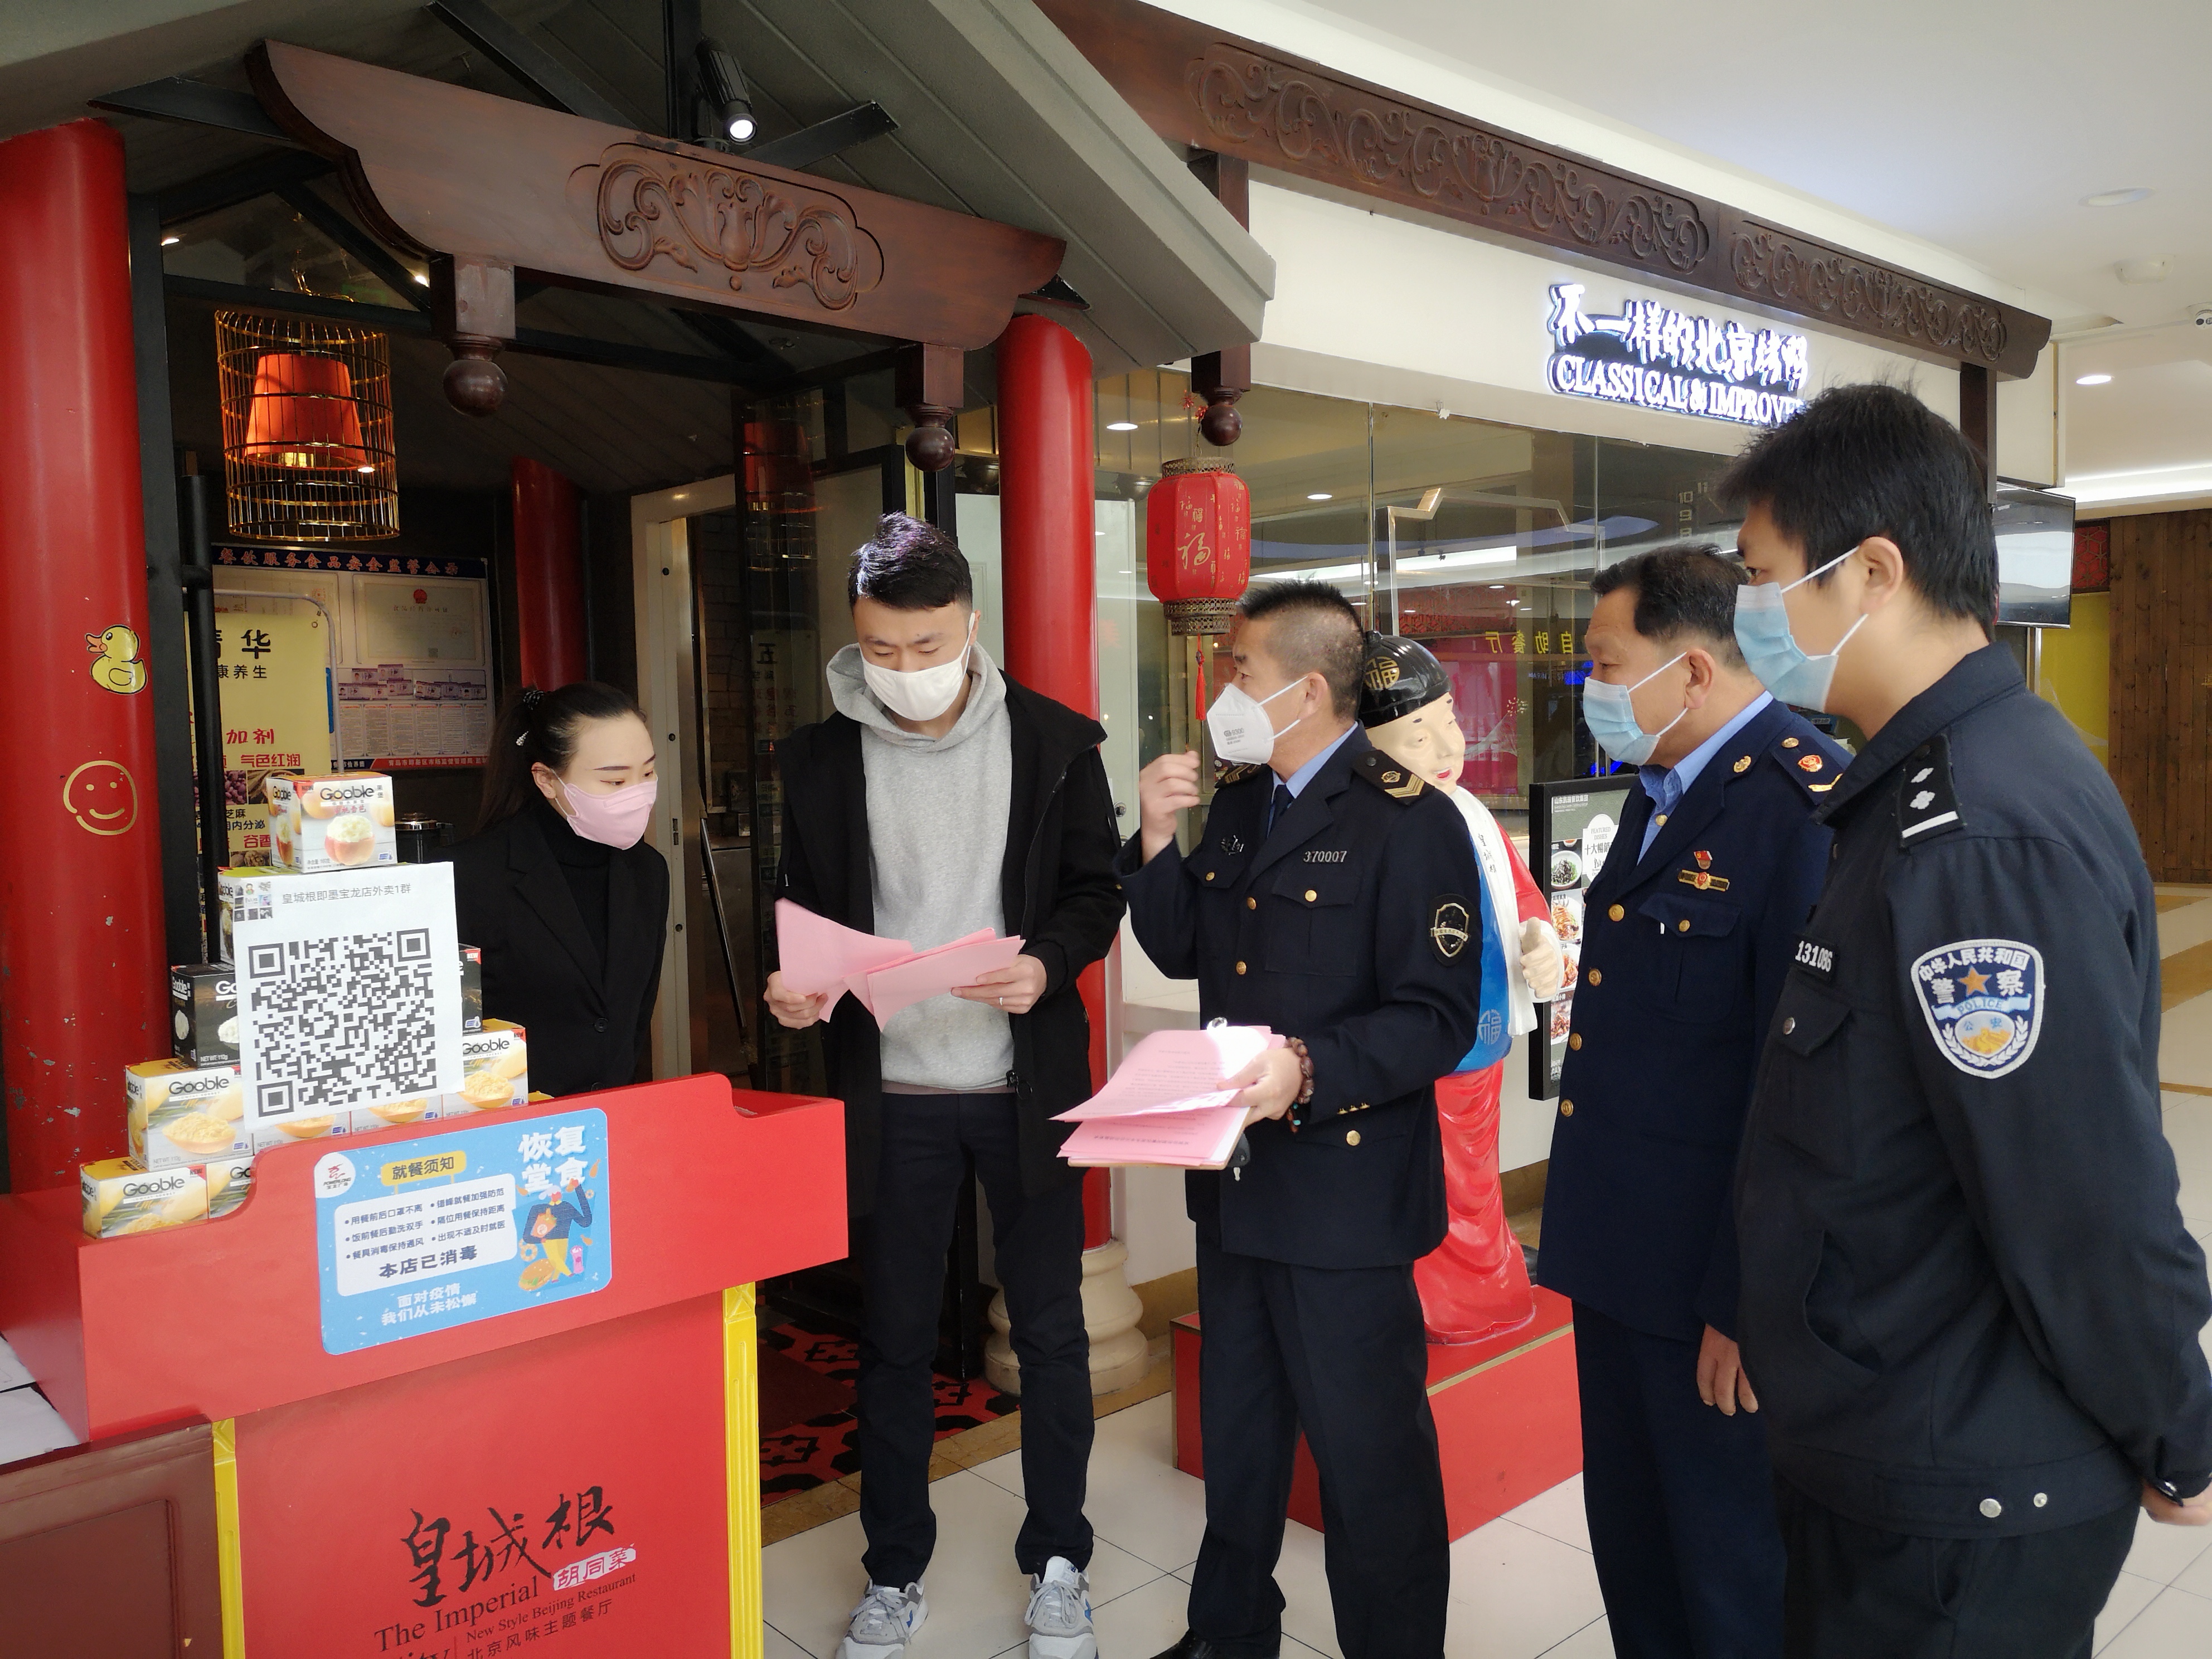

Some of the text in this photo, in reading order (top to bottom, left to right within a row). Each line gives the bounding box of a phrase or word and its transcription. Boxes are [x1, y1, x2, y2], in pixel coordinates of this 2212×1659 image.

[1550, 355, 1689, 413] CLASSICAL
[219, 547, 459, 575] 餐饮服务食品安全监管公示
[241, 754, 300, 768] 气色红润
[320, 785, 375, 801] Gooble
[1303, 851, 1347, 863] 370007
[282, 883, 411, 905] 皇城根即墨宝龙店外卖1群
[1918, 946, 2030, 982] 中华人民共和国
[1958, 996, 2002, 1016] POLICE
[462, 1038, 510, 1055] Gooble
[169, 1076, 230, 1095] Gooble
[518, 1125, 586, 1163] 恢复
[392, 1156, 455, 1180] 就餐须知
[123, 1176, 185, 1197] Gooble
[437, 1189, 505, 1209] 错峰就餐加强防范
[351, 1204, 423, 1226] 用餐前后口罩不离
[437, 1204, 505, 1226] 隔位用餐保持距离
[351, 1221, 424, 1243] 饭前餐后勤洗双手
[438, 1221, 506, 1242] 出现不适及时就医
[353, 1238, 424, 1260] 餐具消毒保持通风
[379, 1245, 478, 1279] 本店已消毒
[397, 1283, 461, 1308] 面对疫情
[381, 1291, 478, 1326] 我们从未松懈
[400, 1485, 614, 1608] 皇城根
[557, 1549, 629, 1588] 胡同菜
[374, 1576, 539, 1652] The Imperial
[467, 1573, 636, 1643] New Style Beijing Restaurant
[468, 1598, 613, 1659] 北京风味主题餐厅
